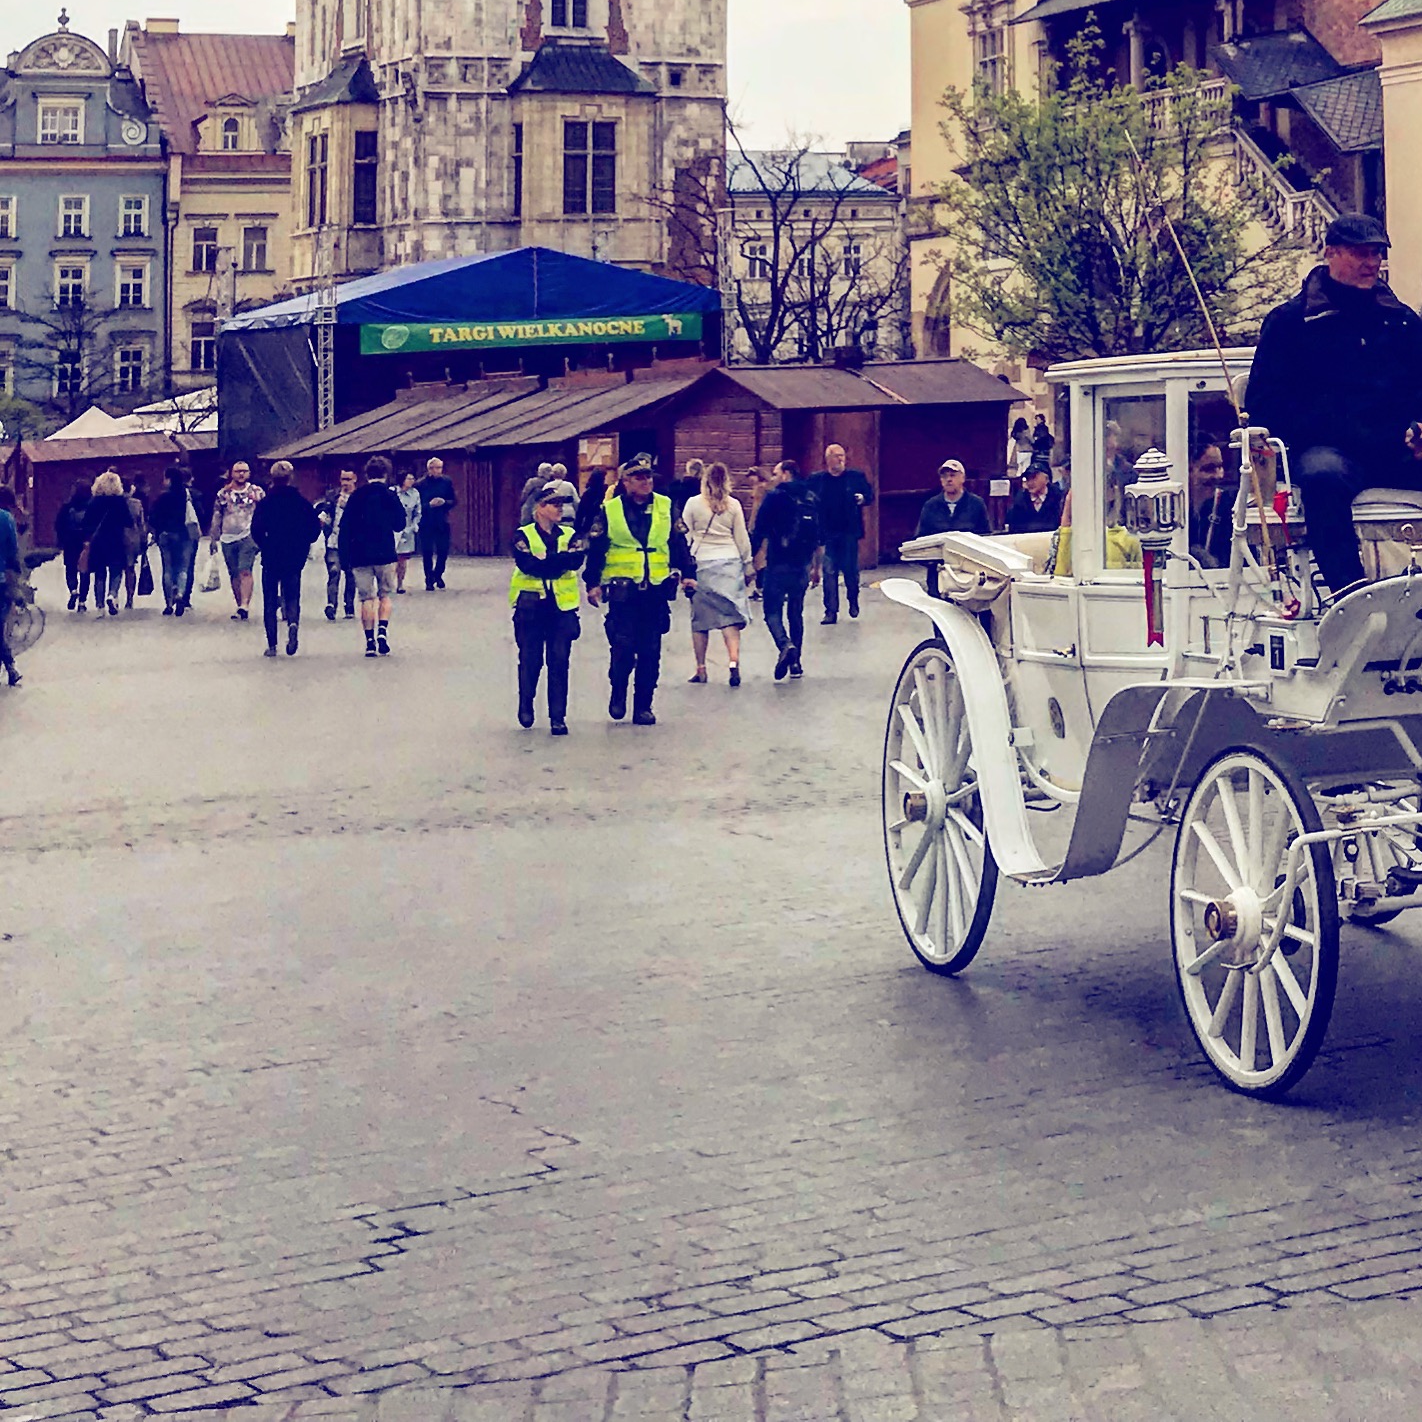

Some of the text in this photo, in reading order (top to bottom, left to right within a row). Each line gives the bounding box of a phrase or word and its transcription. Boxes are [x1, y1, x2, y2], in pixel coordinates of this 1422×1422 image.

[429, 319, 645, 344] TARGI WIELKANOCNE
[1274, 648, 1280, 667] 1
